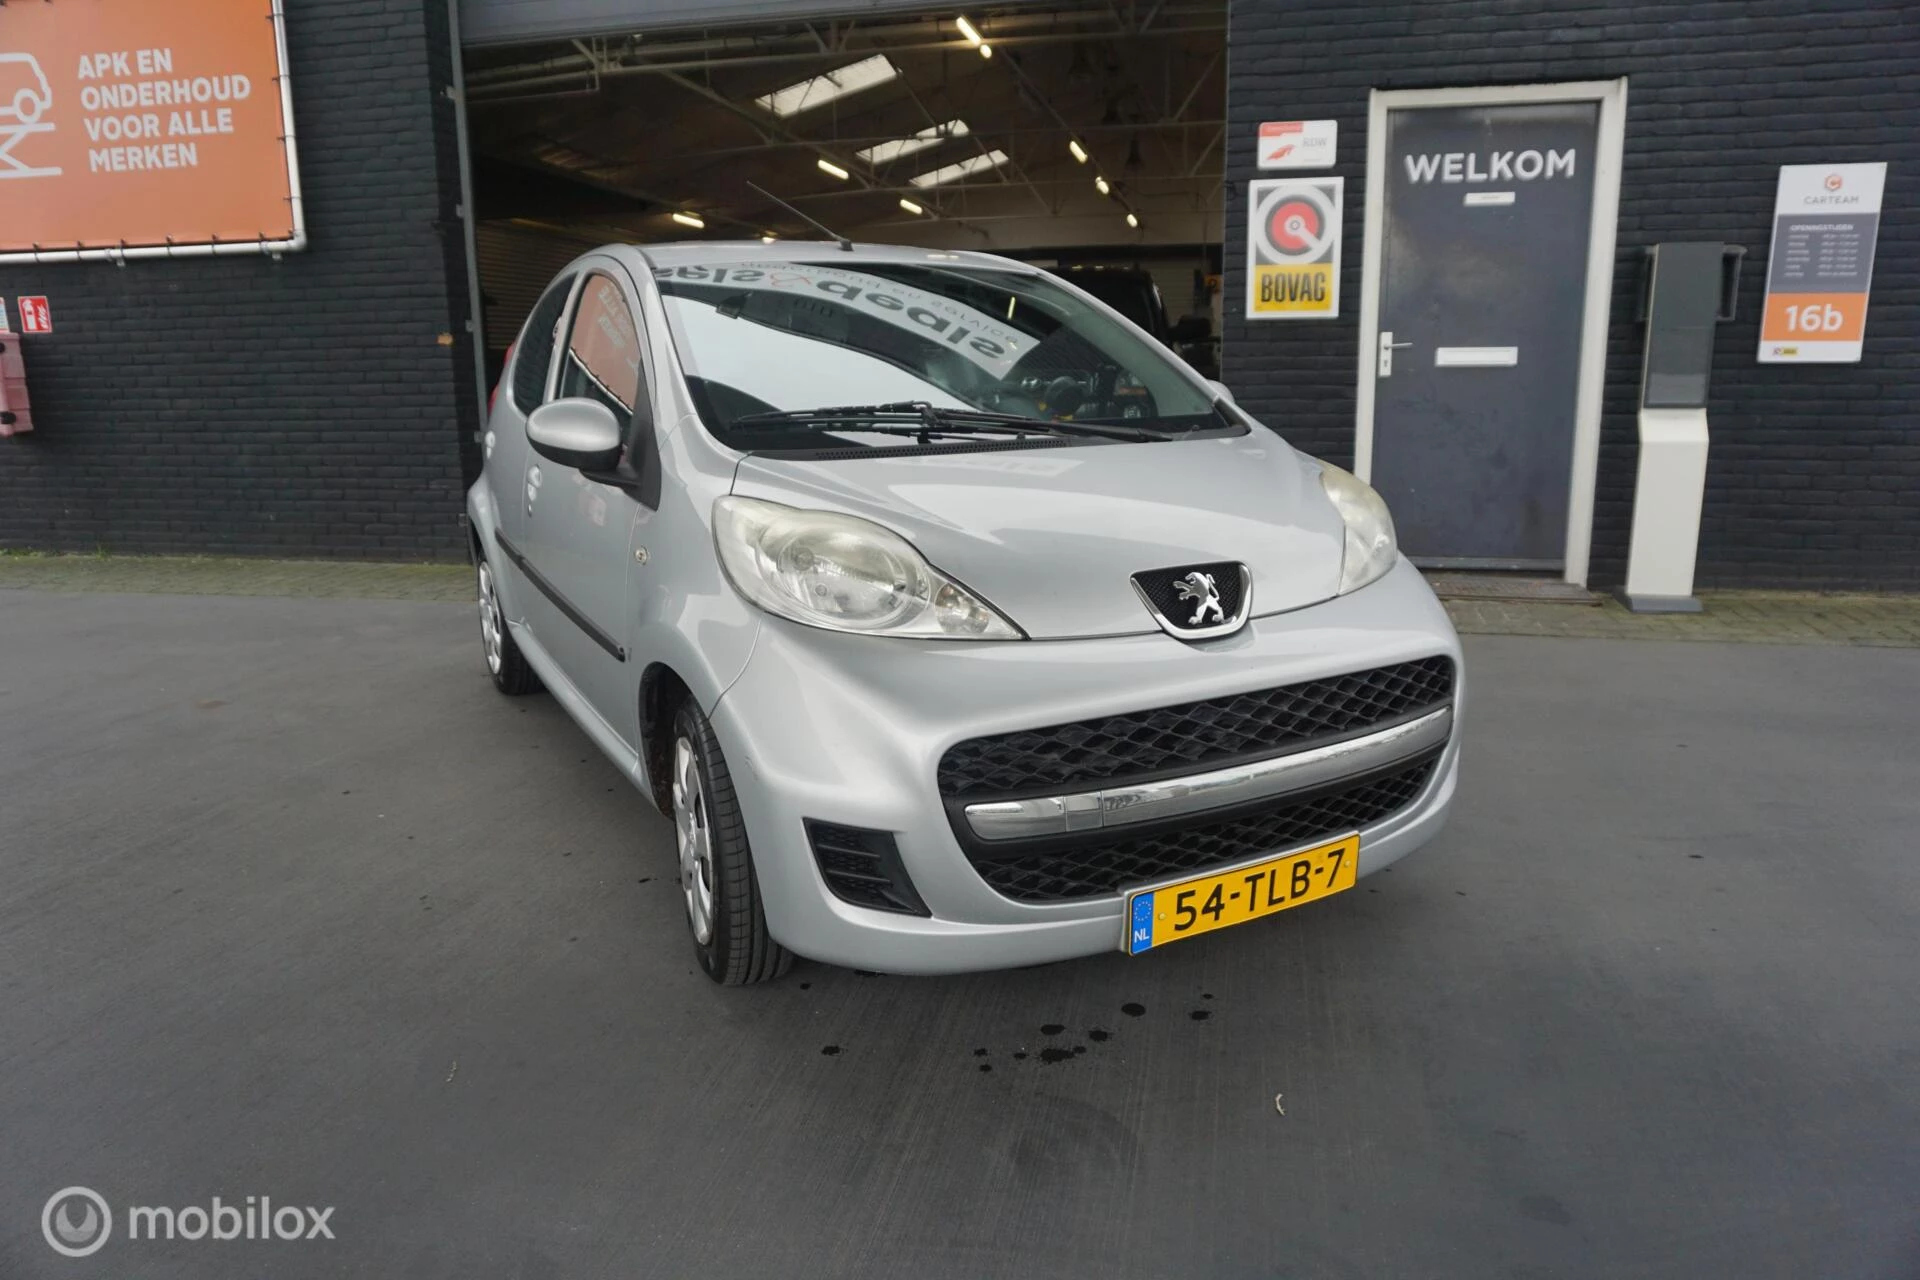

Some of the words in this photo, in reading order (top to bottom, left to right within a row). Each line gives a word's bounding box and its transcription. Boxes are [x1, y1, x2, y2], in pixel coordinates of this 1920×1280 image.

[78, 52, 131, 80] APK
[136, 48, 173, 75] EN
[80, 75, 251, 111] ONDERHOUD
[84, 113, 160, 142] VOOR
[168, 108, 234, 136] ALLE
[88, 142, 198, 173] MERKEN
[1404, 149, 1577, 182] WELKOM
[1803, 195, 1860, 206] CARTEAM
[1260, 271, 1327, 304] BOVAG
[1785, 303, 1844, 333] 16b
[1174, 847, 1346, 931] 54-TLB-7
[1134, 928, 1150, 943] NL
